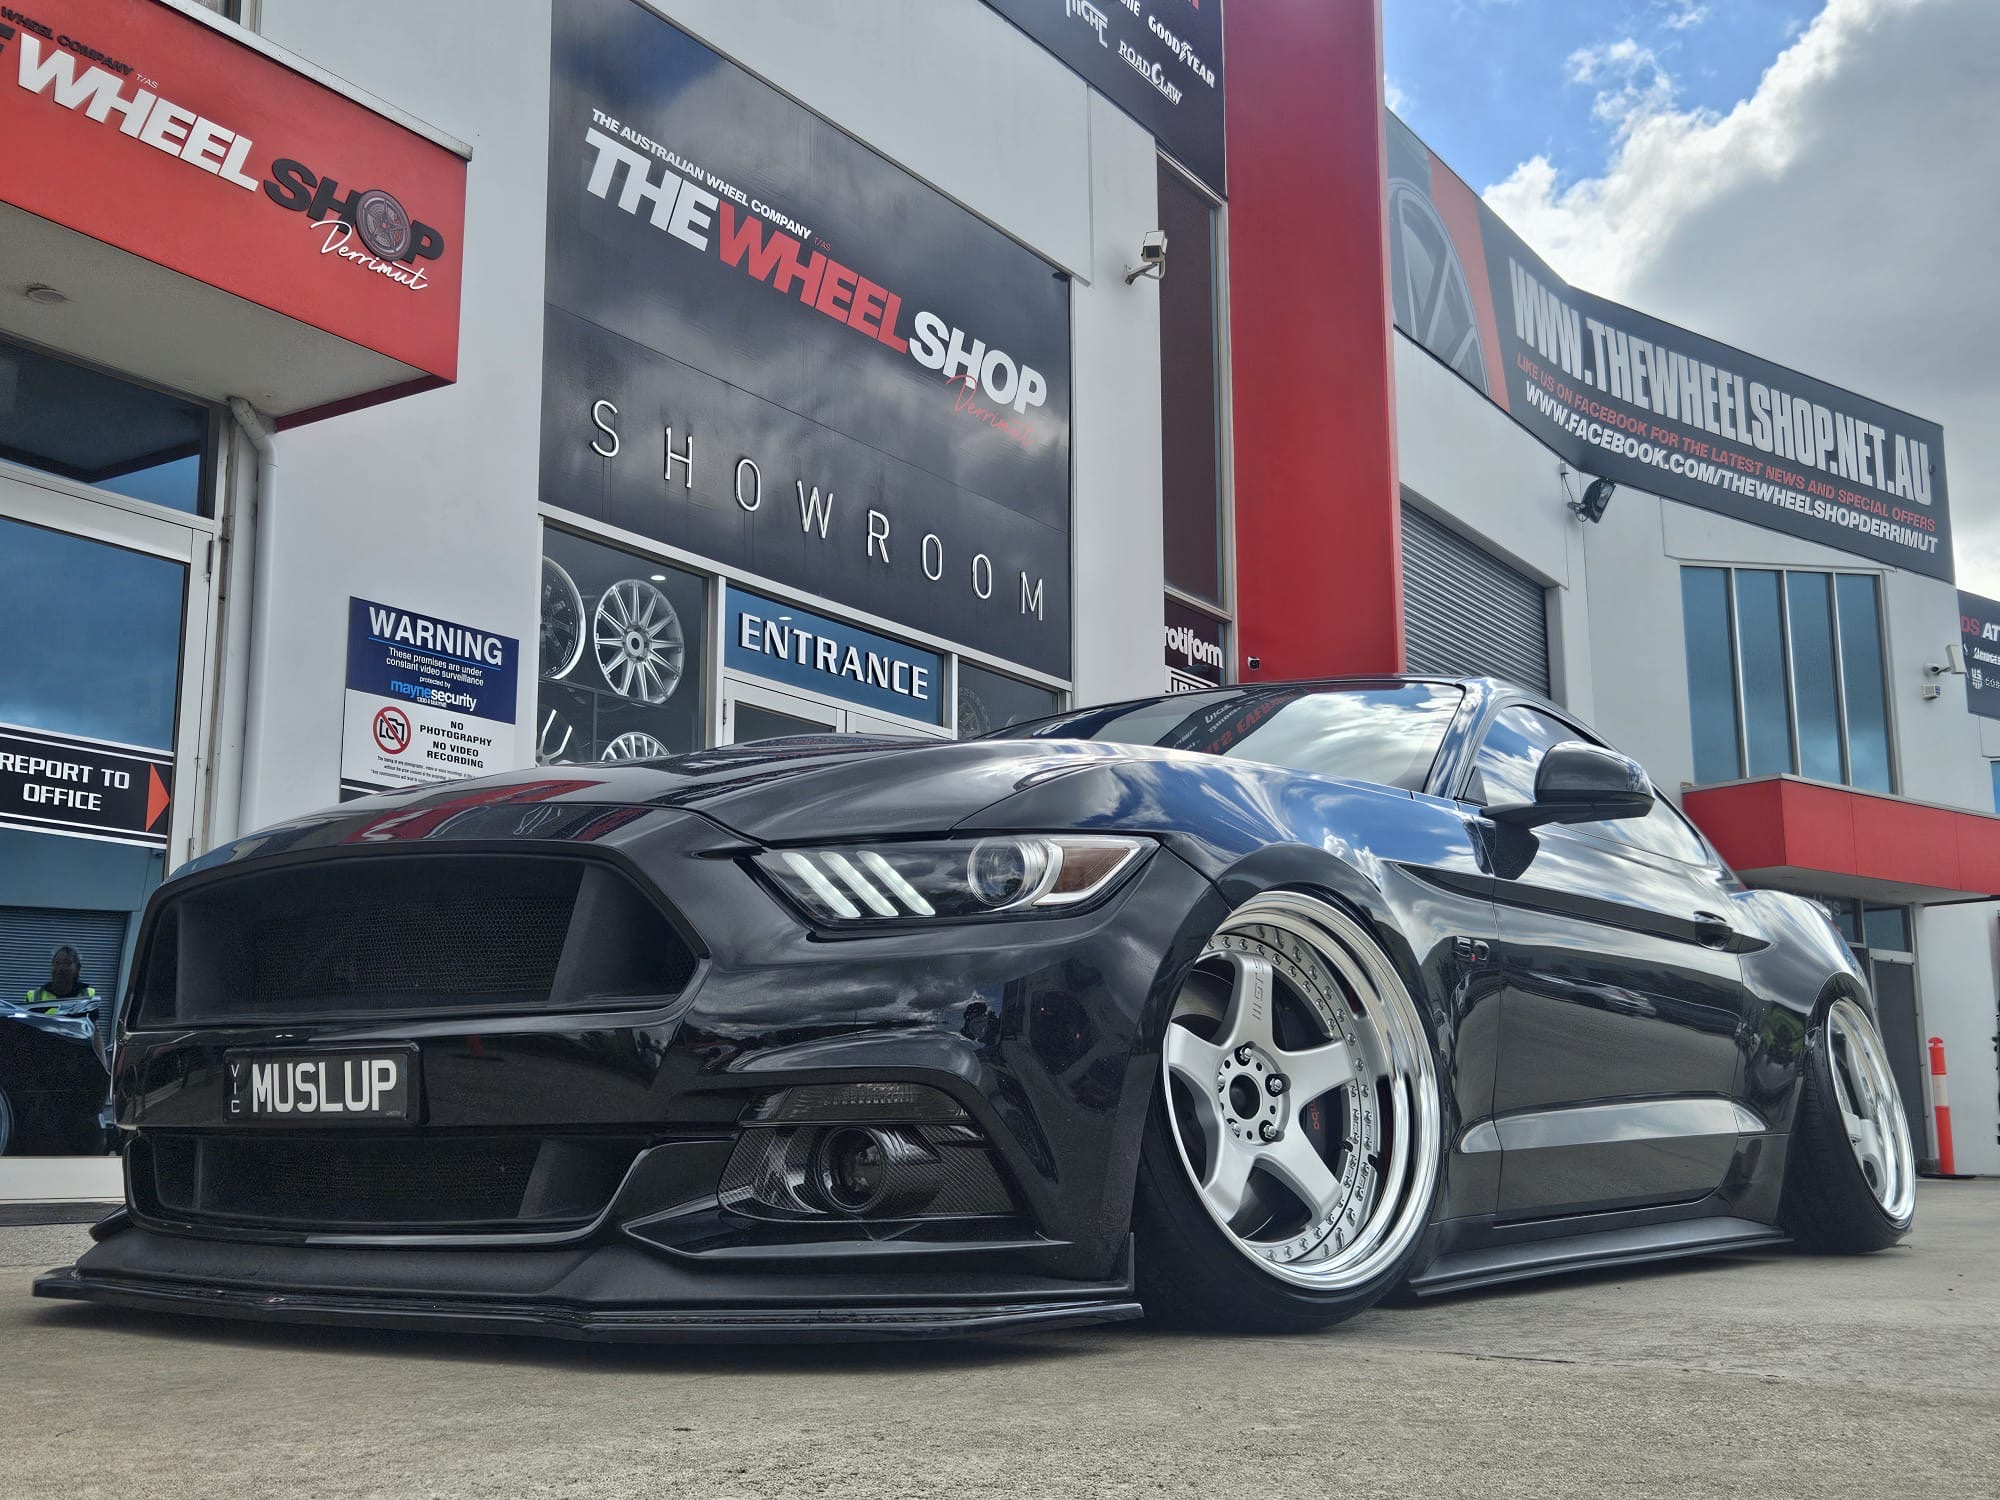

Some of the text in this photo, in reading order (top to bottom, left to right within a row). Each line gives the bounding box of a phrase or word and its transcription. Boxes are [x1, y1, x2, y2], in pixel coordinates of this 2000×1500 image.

[1, 6, 53, 40] WHEEL
[57, 35, 133, 76] COMPANY
[137, 74, 159, 89] T/AS
[1148, 15, 1215, 89] GOODYEAR
[18, 32, 259, 192] WHEEL
[592, 107, 620, 133] THE
[621, 126, 704, 181] AUSTRALIAN
[706, 172, 749, 207] WHEEL
[751, 199, 812, 240] COMPANY
[310, 219, 428, 290] Derrimut
[585, 127, 1047, 414] THE WHEEL SHOP
[1508, 256, 1933, 505] WWW.THEWHEELSHOP.NET.AU
[1517, 352, 1935, 532] LIKE US ON FACEBOOK FOR THE LATEST NEWS AND SPECIAL OFFERS
[1526, 381, 1938, 554] WWW.FACEBOOK.COM/THEWHEELSHOPDERRIMUT
[590, 400, 1044, 621] SHOWROOM
[369, 606, 502, 665] WARNING
[389, 647, 482, 677] These premises are under
[739, 612, 928, 700] ENTRANCE
[386, 657, 484, 686] constant video surveillance
[420, 677, 451, 689] protected by
[420, 724, 492, 746] PHOTOGRAPHY
[433, 740, 479, 757] NO VIDEO
[450, 720, 464, 731] NO
[0, 752, 131, 790] REPORT TO
[426, 750, 484, 769] RECORDING
[23, 782, 102, 812] OFFICE
[231, 1064, 240, 1113] VIC
[252, 1060, 397, 1113] MUSLUP
